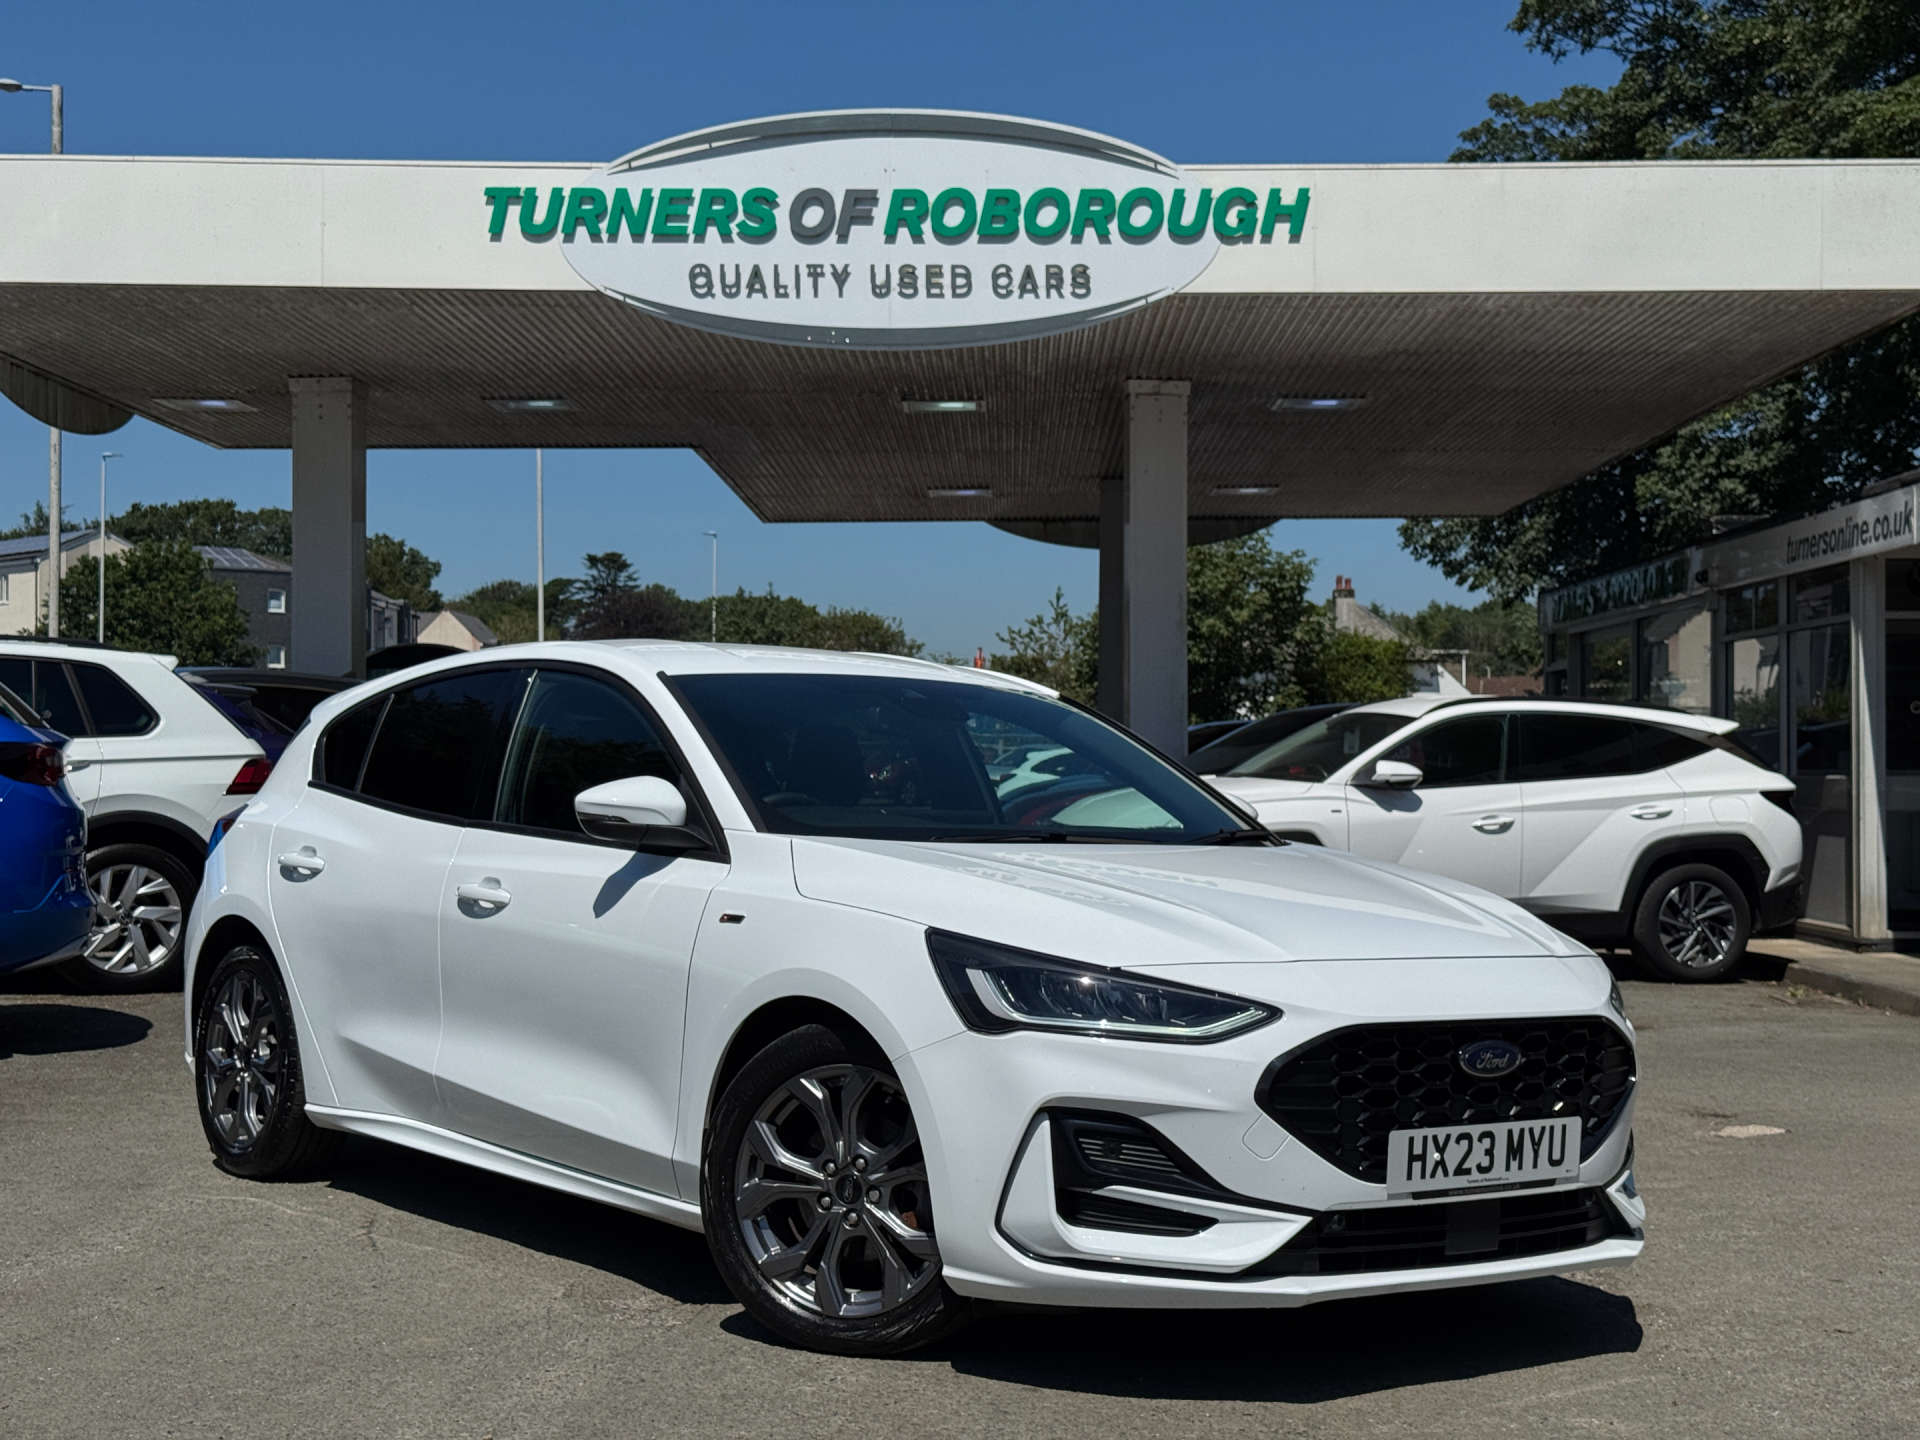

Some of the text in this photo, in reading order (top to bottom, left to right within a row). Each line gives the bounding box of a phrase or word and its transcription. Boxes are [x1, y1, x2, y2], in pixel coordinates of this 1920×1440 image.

[484, 186, 1311, 243] TURNERS OF ROBOROUGH
[689, 263, 1093, 299] QUALITY USED CARS
[1786, 500, 1913, 564] turnersonline.co.uk
[1476, 1050, 1510, 1069] Ford
[1406, 1124, 1568, 1181] HX23 MYU
